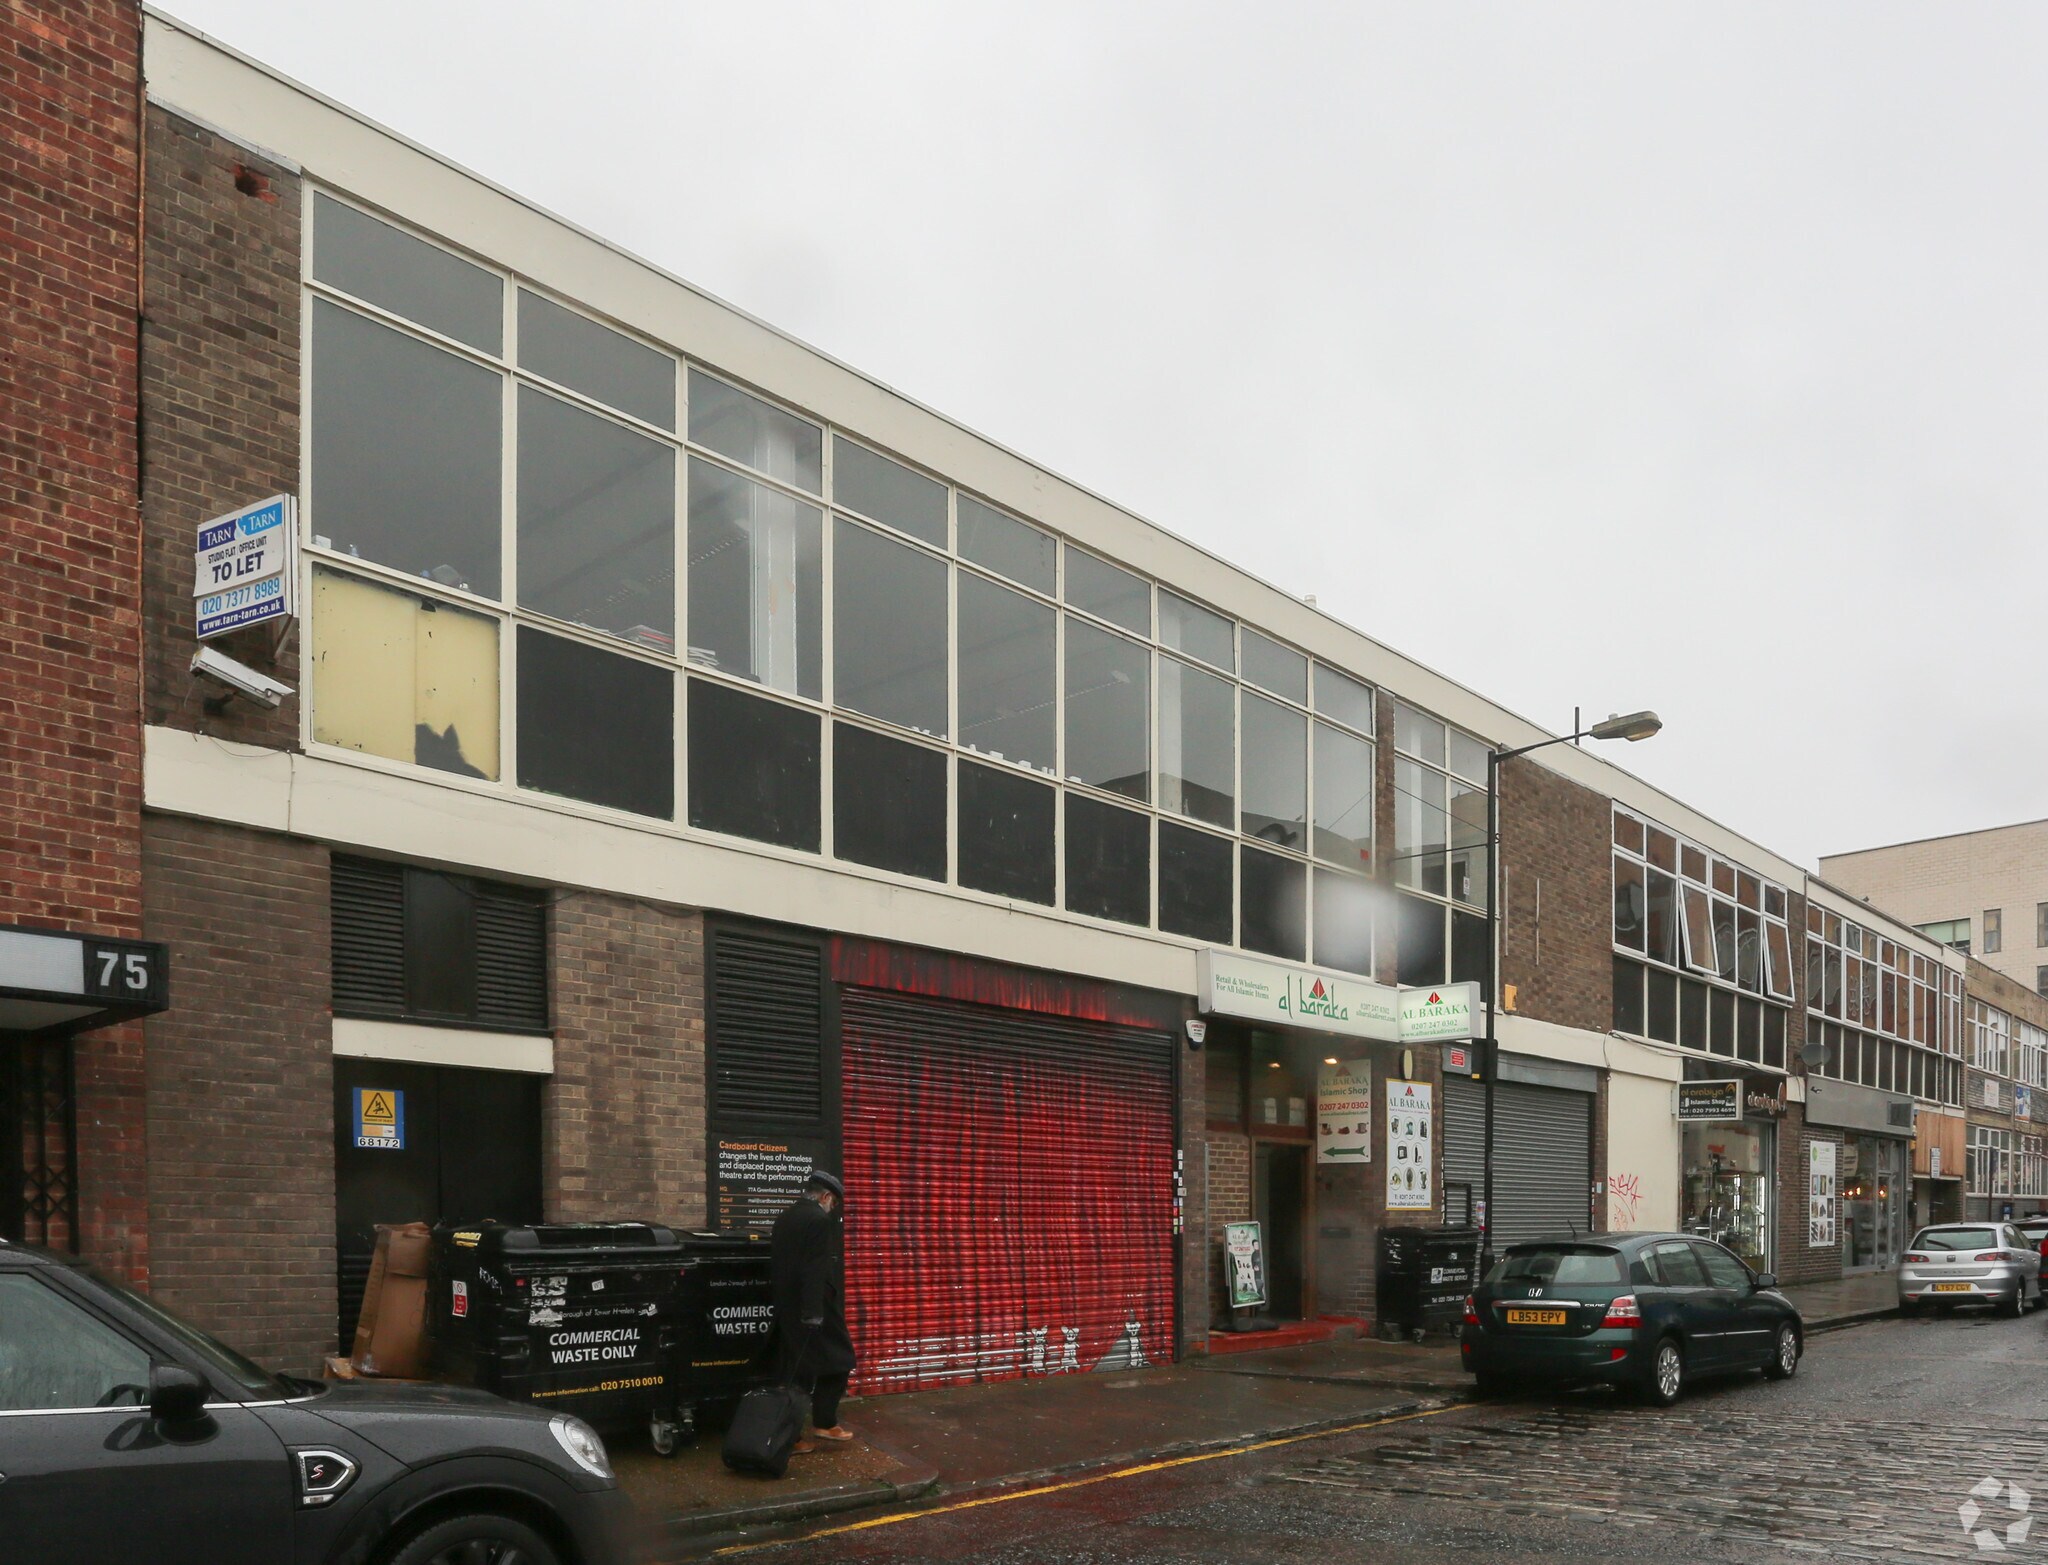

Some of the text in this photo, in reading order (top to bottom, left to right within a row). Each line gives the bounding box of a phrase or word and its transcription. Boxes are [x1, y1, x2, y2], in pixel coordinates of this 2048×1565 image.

[205, 527, 232, 546] TARN
[248, 510, 276, 530] TARN
[208, 536, 267, 564] STUDIO FLAT OFFICE UNIT
[212, 551, 264, 583] TO LET
[202, 577, 280, 615] 020 7377 8989
[202, 600, 281, 630] www.tarn-tarn.co.uk
[97, 951, 148, 989] 75
[1216, 975, 1231, 984] Retail
[1238, 978, 1269, 992] Wholesalers
[1227, 984, 1235, 992] All
[1235, 987, 1254, 996] Islamic
[1255, 990, 1269, 999] Items
[1299, 976, 1348, 1020] baraka
[1401, 1004, 1469, 1020] AL BARAKA
[1412, 1019, 1458, 1030] 0207 247 0302
[1333, 1077, 1369, 1086] BARAKA
[1320, 1087, 1368, 1096] Islamic Shop
[1690, 1088, 1724, 1098] arabiya
[1319, 1101, 1369, 1111] 0207 247 0302
[1389, 1097, 1431, 1110] AL BARAKA
[360, 1138, 399, 1148] 68172
[719, 1140, 788, 1152] Cardboard Citizens
[719, 1151, 812, 1163] changes the lives of homeless
[719, 1161, 812, 1173] and displaced people through
[719, 1171, 742, 1180] theatre
[743, 1172, 755, 1180] and
[756, 1172, 767, 1180] the
[768, 1173, 802, 1183] performing
[594, 1308, 611, 1316] Tower
[713, 1305, 774, 1319] COMMERC
[1511, 1311, 1562, 1322] LB53 EPY
[715, 1322, 757, 1335] WASTE
[549, 1328, 641, 1346] COMMERCIAL
[551, 1345, 638, 1364] WASTE ONLY
[557, 1386, 588, 1396] information
[600, 1381, 618, 1391] 020
[619, 1378, 641, 1389] 7510
[642, 1375, 664, 1387] 0010
